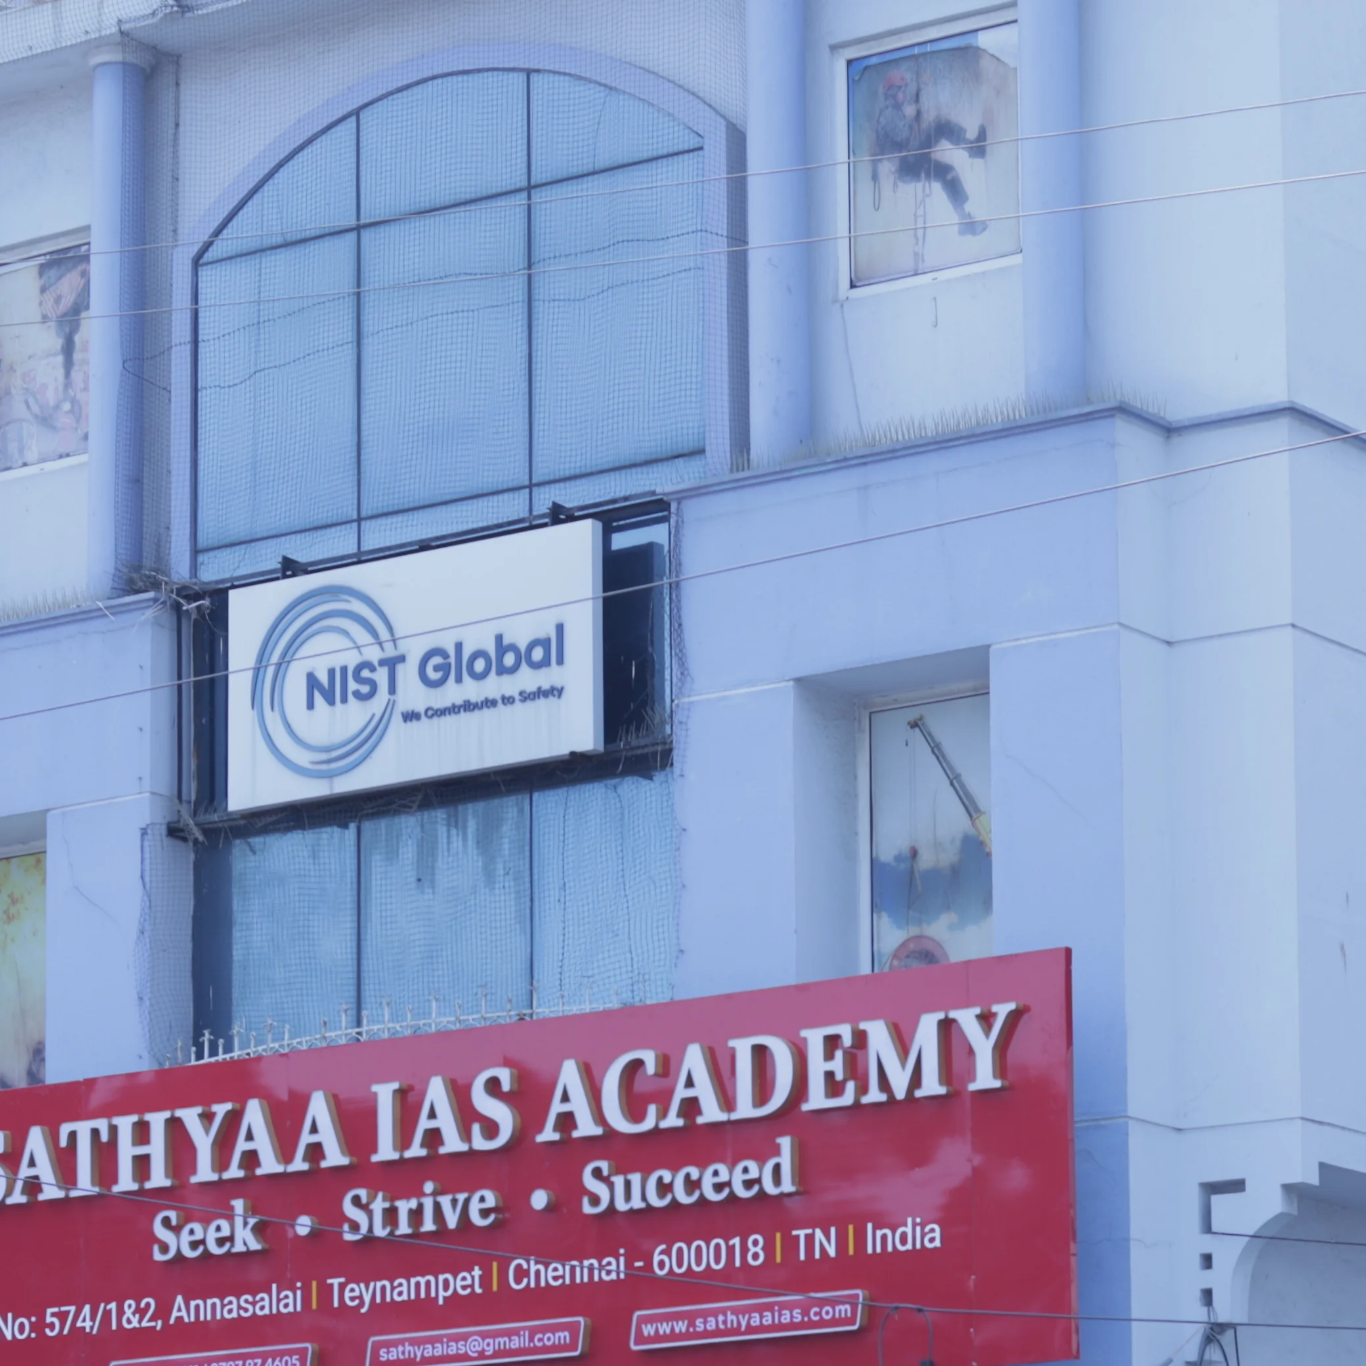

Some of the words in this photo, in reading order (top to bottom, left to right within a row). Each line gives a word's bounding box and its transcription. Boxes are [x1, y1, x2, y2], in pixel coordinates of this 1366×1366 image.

[305, 654, 406, 710] NIST
[418, 623, 565, 688] Global
[401, 709, 421, 723] We
[424, 696, 496, 720] Contribute
[500, 693, 515, 707] to
[518, 684, 565, 705] Safety
[370, 1067, 518, 1163] IAS
[536, 1002, 1021, 1142] ACADEMY
[152, 1198, 265, 1261] Seek
[342, 1181, 500, 1241] Strive
[582, 1135, 798, 1214] Succeed
[44, 1298, 163, 1338] 574/1&2,
[169, 1282, 302, 1325] Annasalai
[327, 1265, 482, 1314] Teynampet
[508, 1249, 625, 1289] Chennai
[652, 1234, 765, 1276] 600018
[792, 1226, 836, 1260] TN
[866, 1218, 941, 1254] India
[641, 1302, 852, 1338] www.sathyaaias.com
[379, 1327, 570, 1363] sathyaaias@gmail.com
